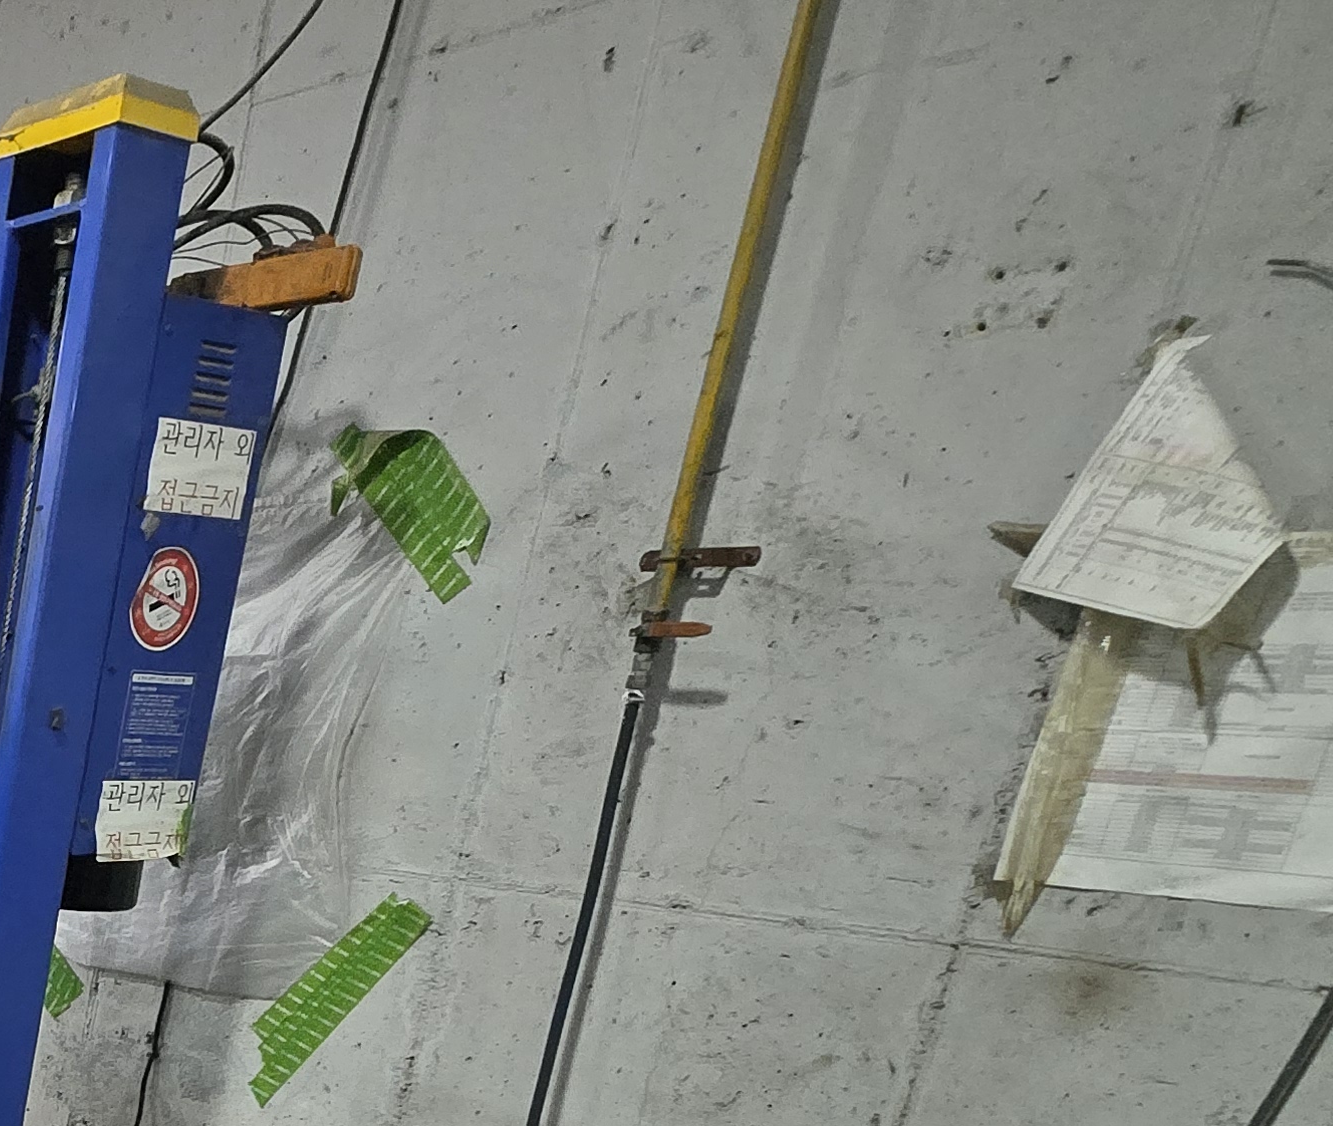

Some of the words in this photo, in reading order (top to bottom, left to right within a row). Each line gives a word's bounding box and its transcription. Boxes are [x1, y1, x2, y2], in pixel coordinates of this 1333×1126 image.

[162, 421, 224, 461] 관리자
[234, 432, 255, 465] 외
[157, 479, 239, 518] 접근금지
[105, 782, 166, 812] 관리자
[175, 782, 193, 805] 외
[106, 831, 181, 860] 접근금지
